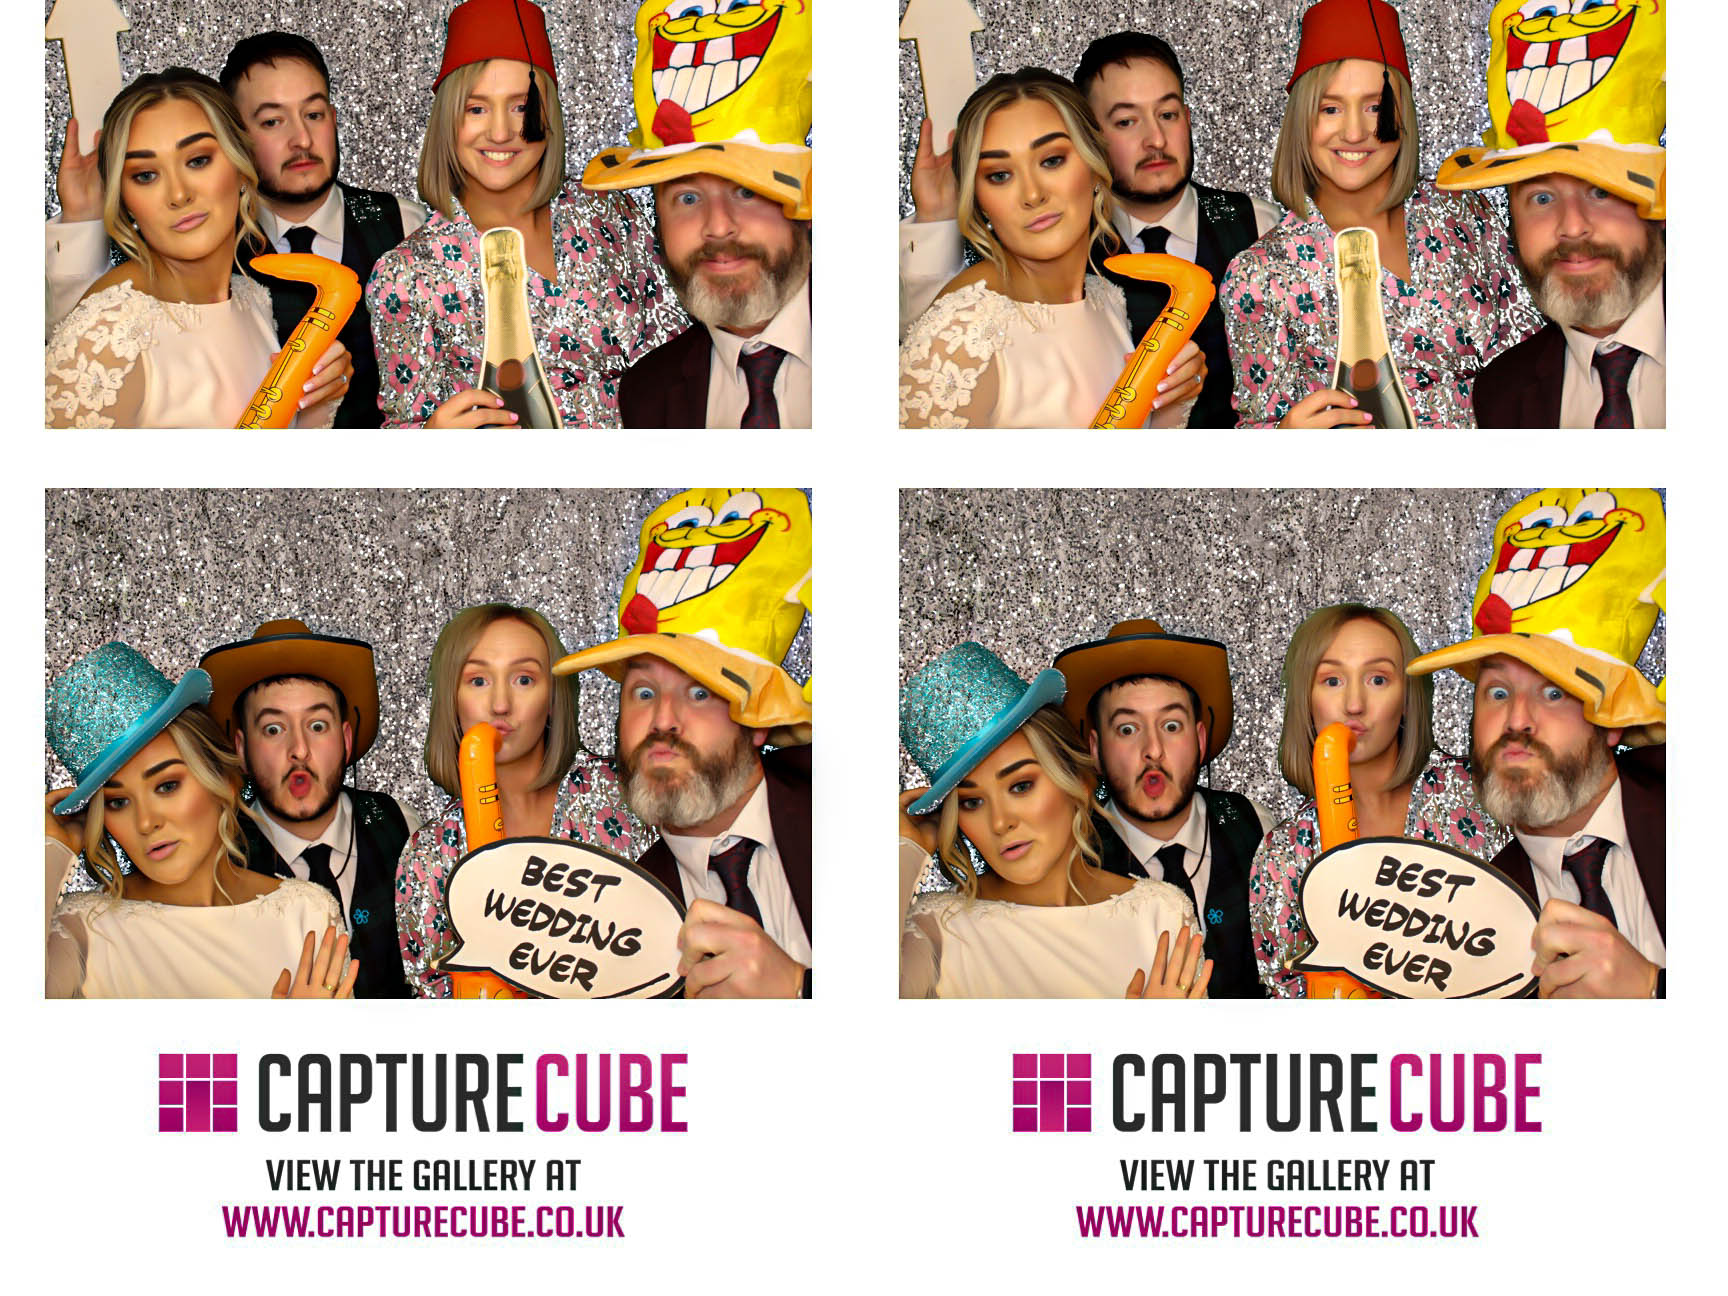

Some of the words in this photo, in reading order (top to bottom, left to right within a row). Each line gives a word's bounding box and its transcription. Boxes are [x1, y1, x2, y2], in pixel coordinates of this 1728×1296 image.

[521, 855, 622, 904] BEST
[1375, 855, 1476, 904] BEST
[484, 888, 643, 957] WEDDING
[1338, 888, 1497, 957] WEDDING
[508, 941, 600, 993] EVER
[1362, 941, 1454, 993] EVER
